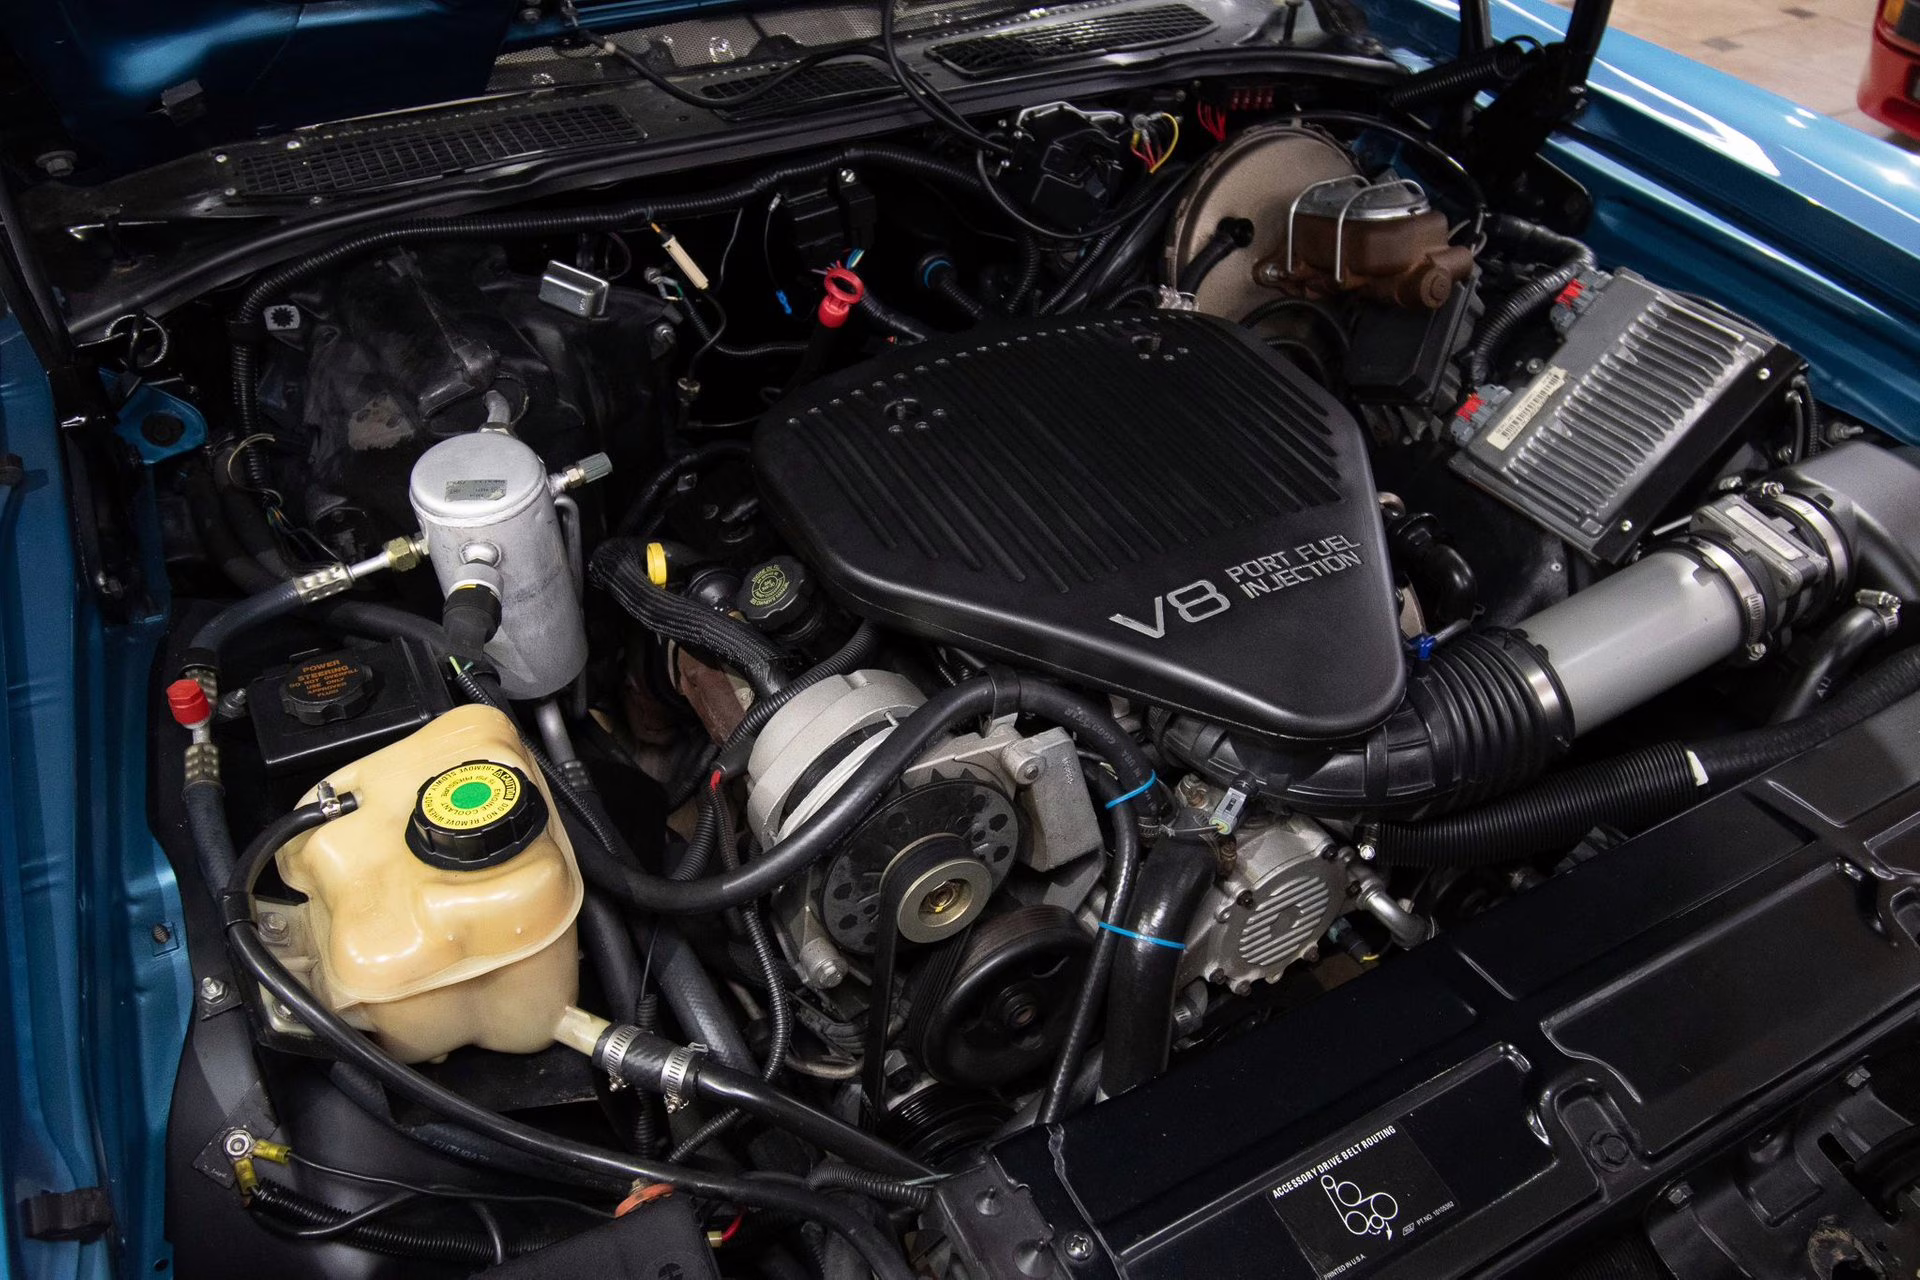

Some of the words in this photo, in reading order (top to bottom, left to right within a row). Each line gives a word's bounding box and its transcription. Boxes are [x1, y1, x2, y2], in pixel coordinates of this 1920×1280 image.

[1225, 551, 1290, 583] PORT
[1295, 535, 1361, 561] FUEL
[1240, 551, 1363, 599] INJECTION
[1108, 580, 1231, 639] V8
[297, 665, 349, 682] STEERING
[302, 659, 340, 672] POWER
[326, 677, 345, 685] ONLY
[460, 765, 491, 773] REMOVE
[432, 772, 457, 791] SLOWLY
[441, 776, 473, 797] PRESSURE
[503, 773, 516, 801] CAUTION
[424, 796, 433, 807] HOT
[481, 788, 501, 812] ENGINE
[498, 802, 509, 812] DO
[427, 807, 444, 823] WHEN
[440, 802, 479, 815] COOLANT
[445, 818, 480, 826] REMOVE
[482, 812, 498, 823] NOT
[1272, 1168, 1318, 1198] ACCESSORY
[1318, 1155, 1342, 1174] DRIVE
[1342, 1143, 1362, 1160] BELT
[1362, 1125, 1396, 1148] ROUTING
[1323, 1265, 1346, 1280] PRINTED
